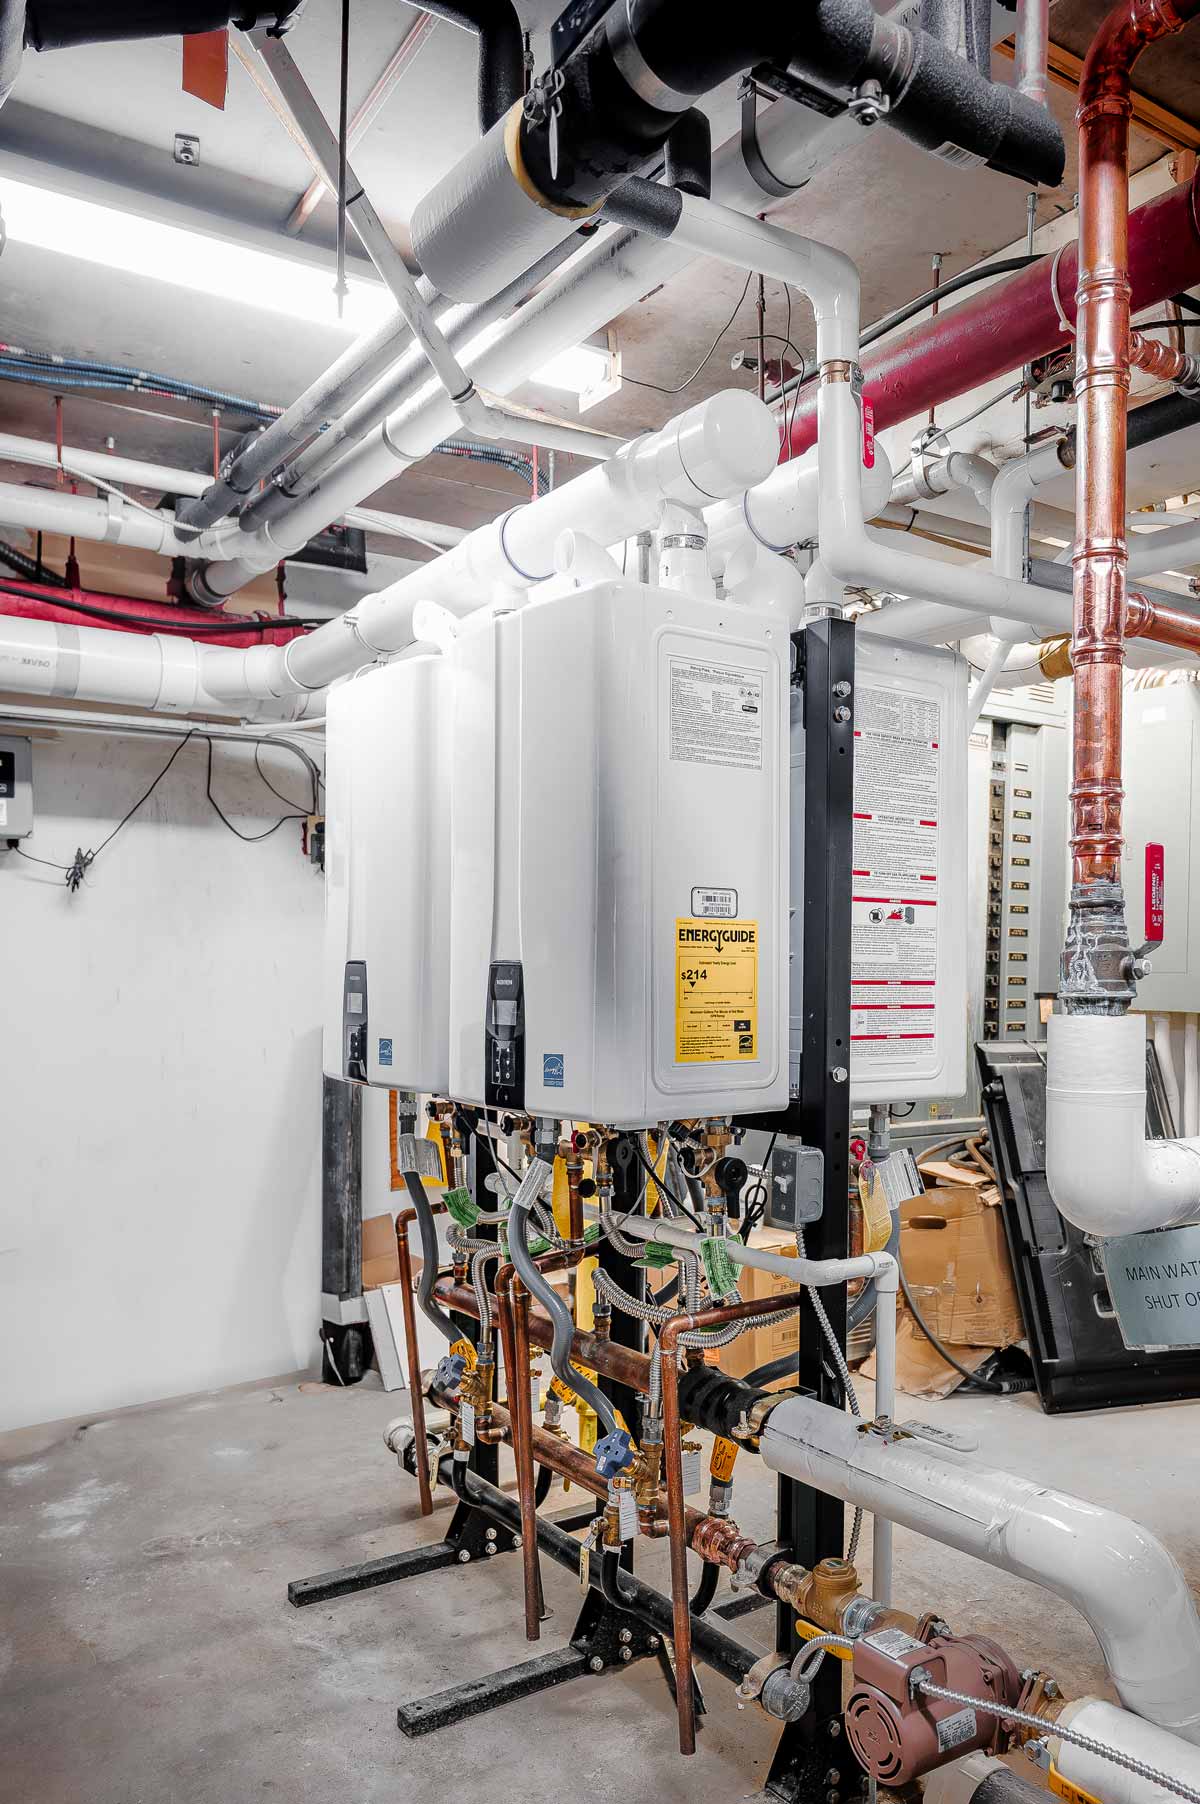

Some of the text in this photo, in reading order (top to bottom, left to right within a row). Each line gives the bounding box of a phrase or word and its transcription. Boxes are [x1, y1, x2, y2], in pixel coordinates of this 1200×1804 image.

[679, 928, 755, 945] ENERGYGUIDE
[681, 969, 707, 981] $214
[1125, 1260, 1200, 1281] MAIN WAT
[1144, 1294, 1180, 1310] SHUT
